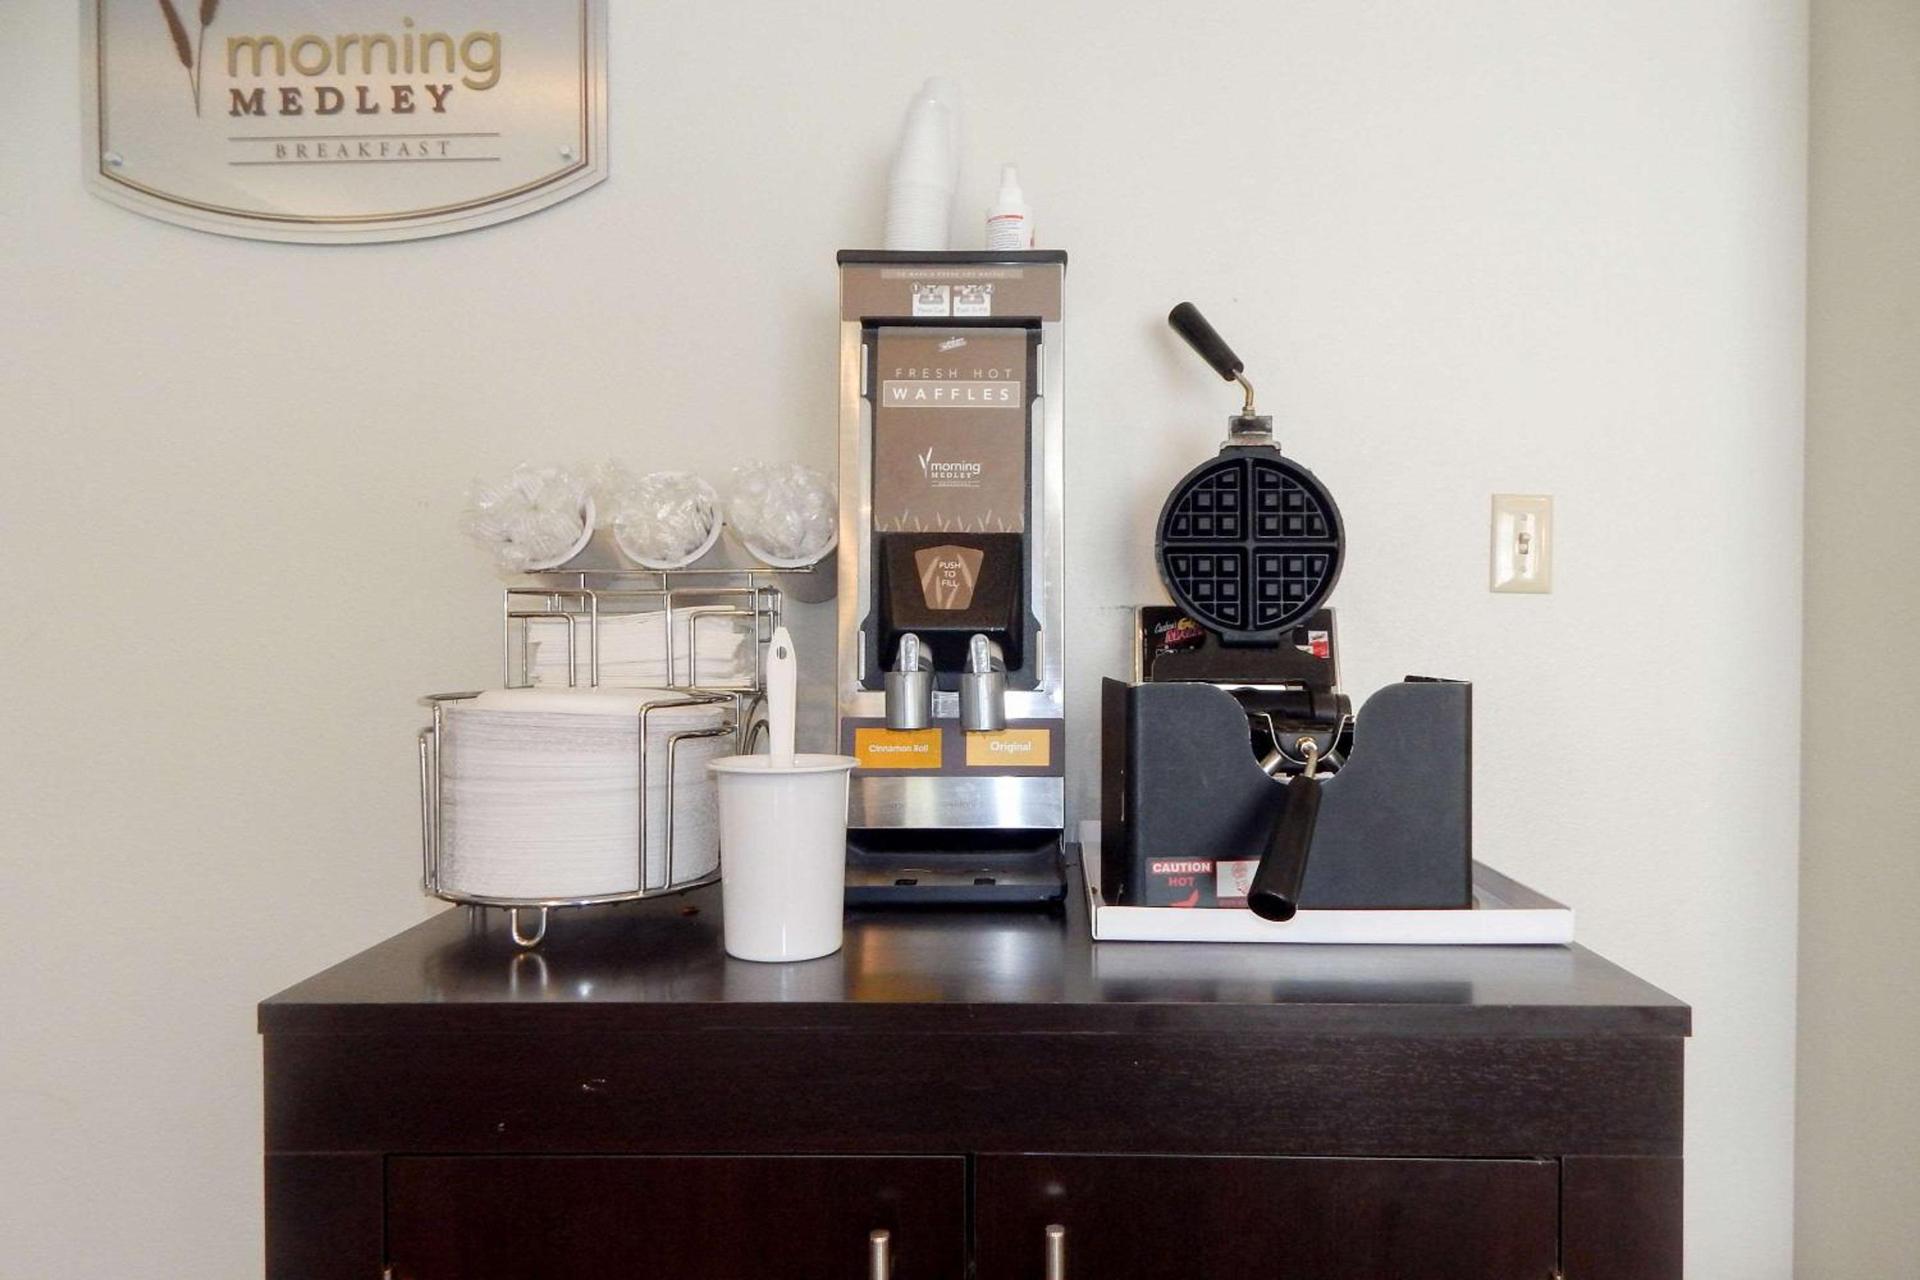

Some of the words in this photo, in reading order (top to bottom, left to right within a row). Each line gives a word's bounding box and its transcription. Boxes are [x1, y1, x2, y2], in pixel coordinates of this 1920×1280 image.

[226, 17, 502, 91] morning
[228, 84, 454, 117] MEDLEY
[274, 139, 451, 159] BREAKFAST
[895, 367, 958, 379] FRESH
[973, 367, 1013, 379] HOT
[891, 387, 1010, 401] WAFFLES
[931, 460, 981, 475] morning
[931, 471, 972, 479] MEDLEY
[939, 561, 961, 569] PUSH
[944, 570, 956, 578] TO
[941, 579, 958, 587] FILL
[868, 743, 912, 753] Cinnamon
[990, 740, 1032, 754] Original
[1152, 862, 1211, 873] CAUTION
[1168, 877, 1194, 887] HOT
